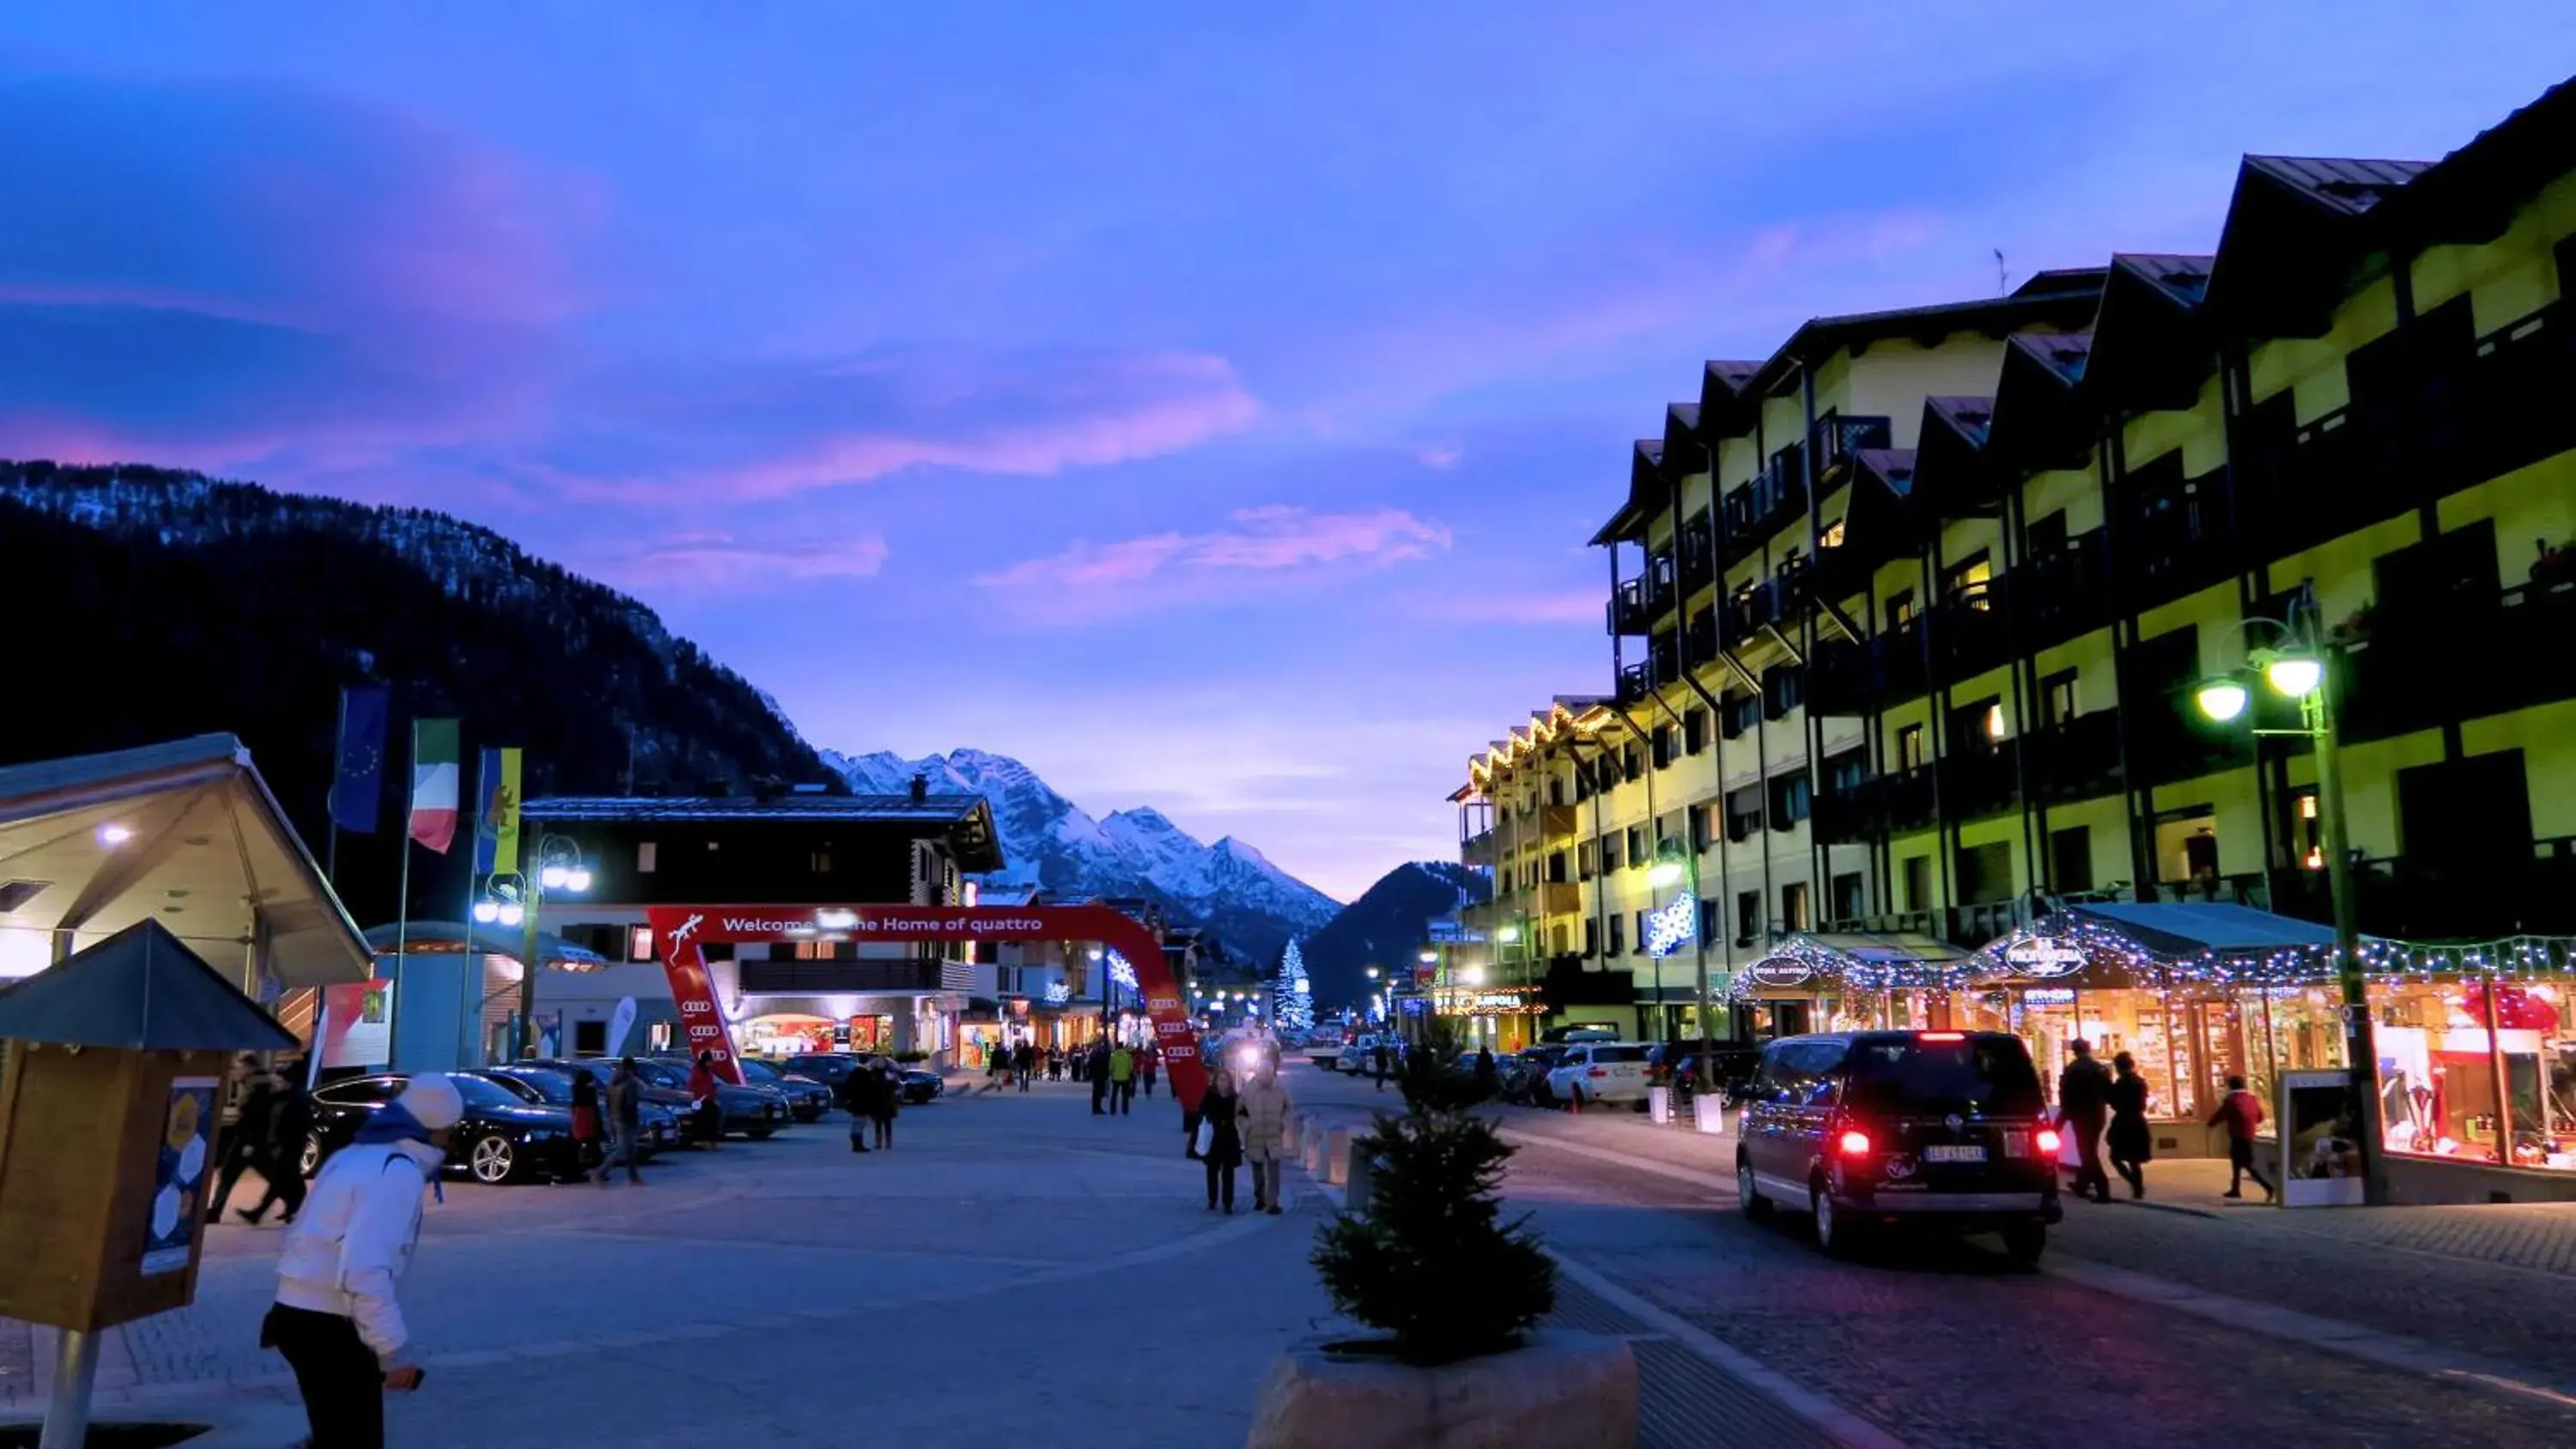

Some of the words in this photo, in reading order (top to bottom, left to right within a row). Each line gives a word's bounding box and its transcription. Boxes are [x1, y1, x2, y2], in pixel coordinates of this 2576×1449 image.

[722, 916, 813, 931] Welcome
[883, 917, 939, 931] Home
[945, 916, 967, 931] of
[969, 918, 1043, 936] quattro
